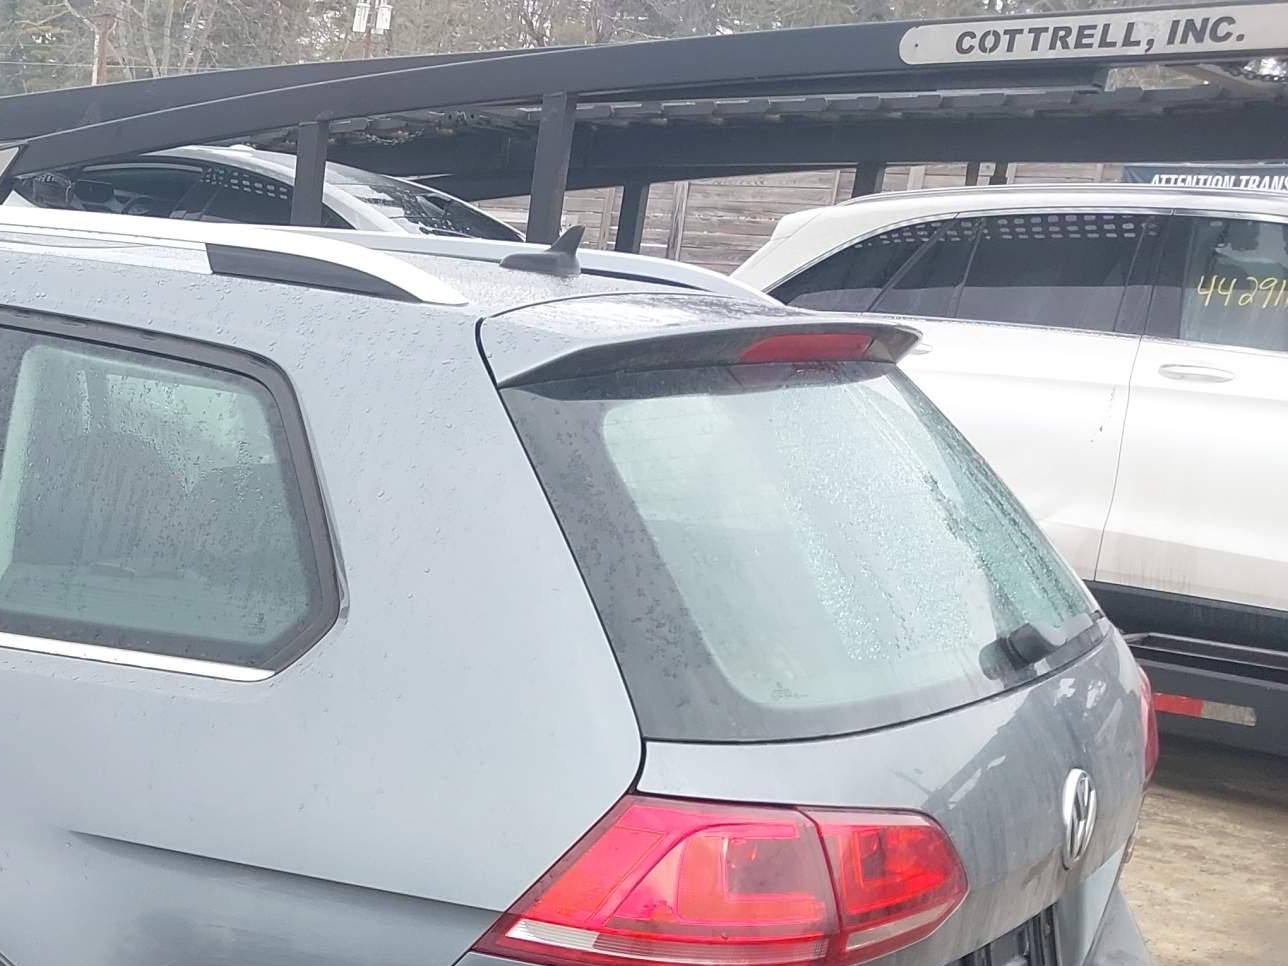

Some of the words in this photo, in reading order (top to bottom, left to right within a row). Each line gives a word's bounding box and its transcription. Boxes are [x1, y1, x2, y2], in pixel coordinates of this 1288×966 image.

[955, 22, 1155, 53] COTTRELL,
[1166, 16, 1246, 46] INC.
[1151, 174, 1235, 188] ATTENTION
[1197, 274, 1288, 309] 44291
